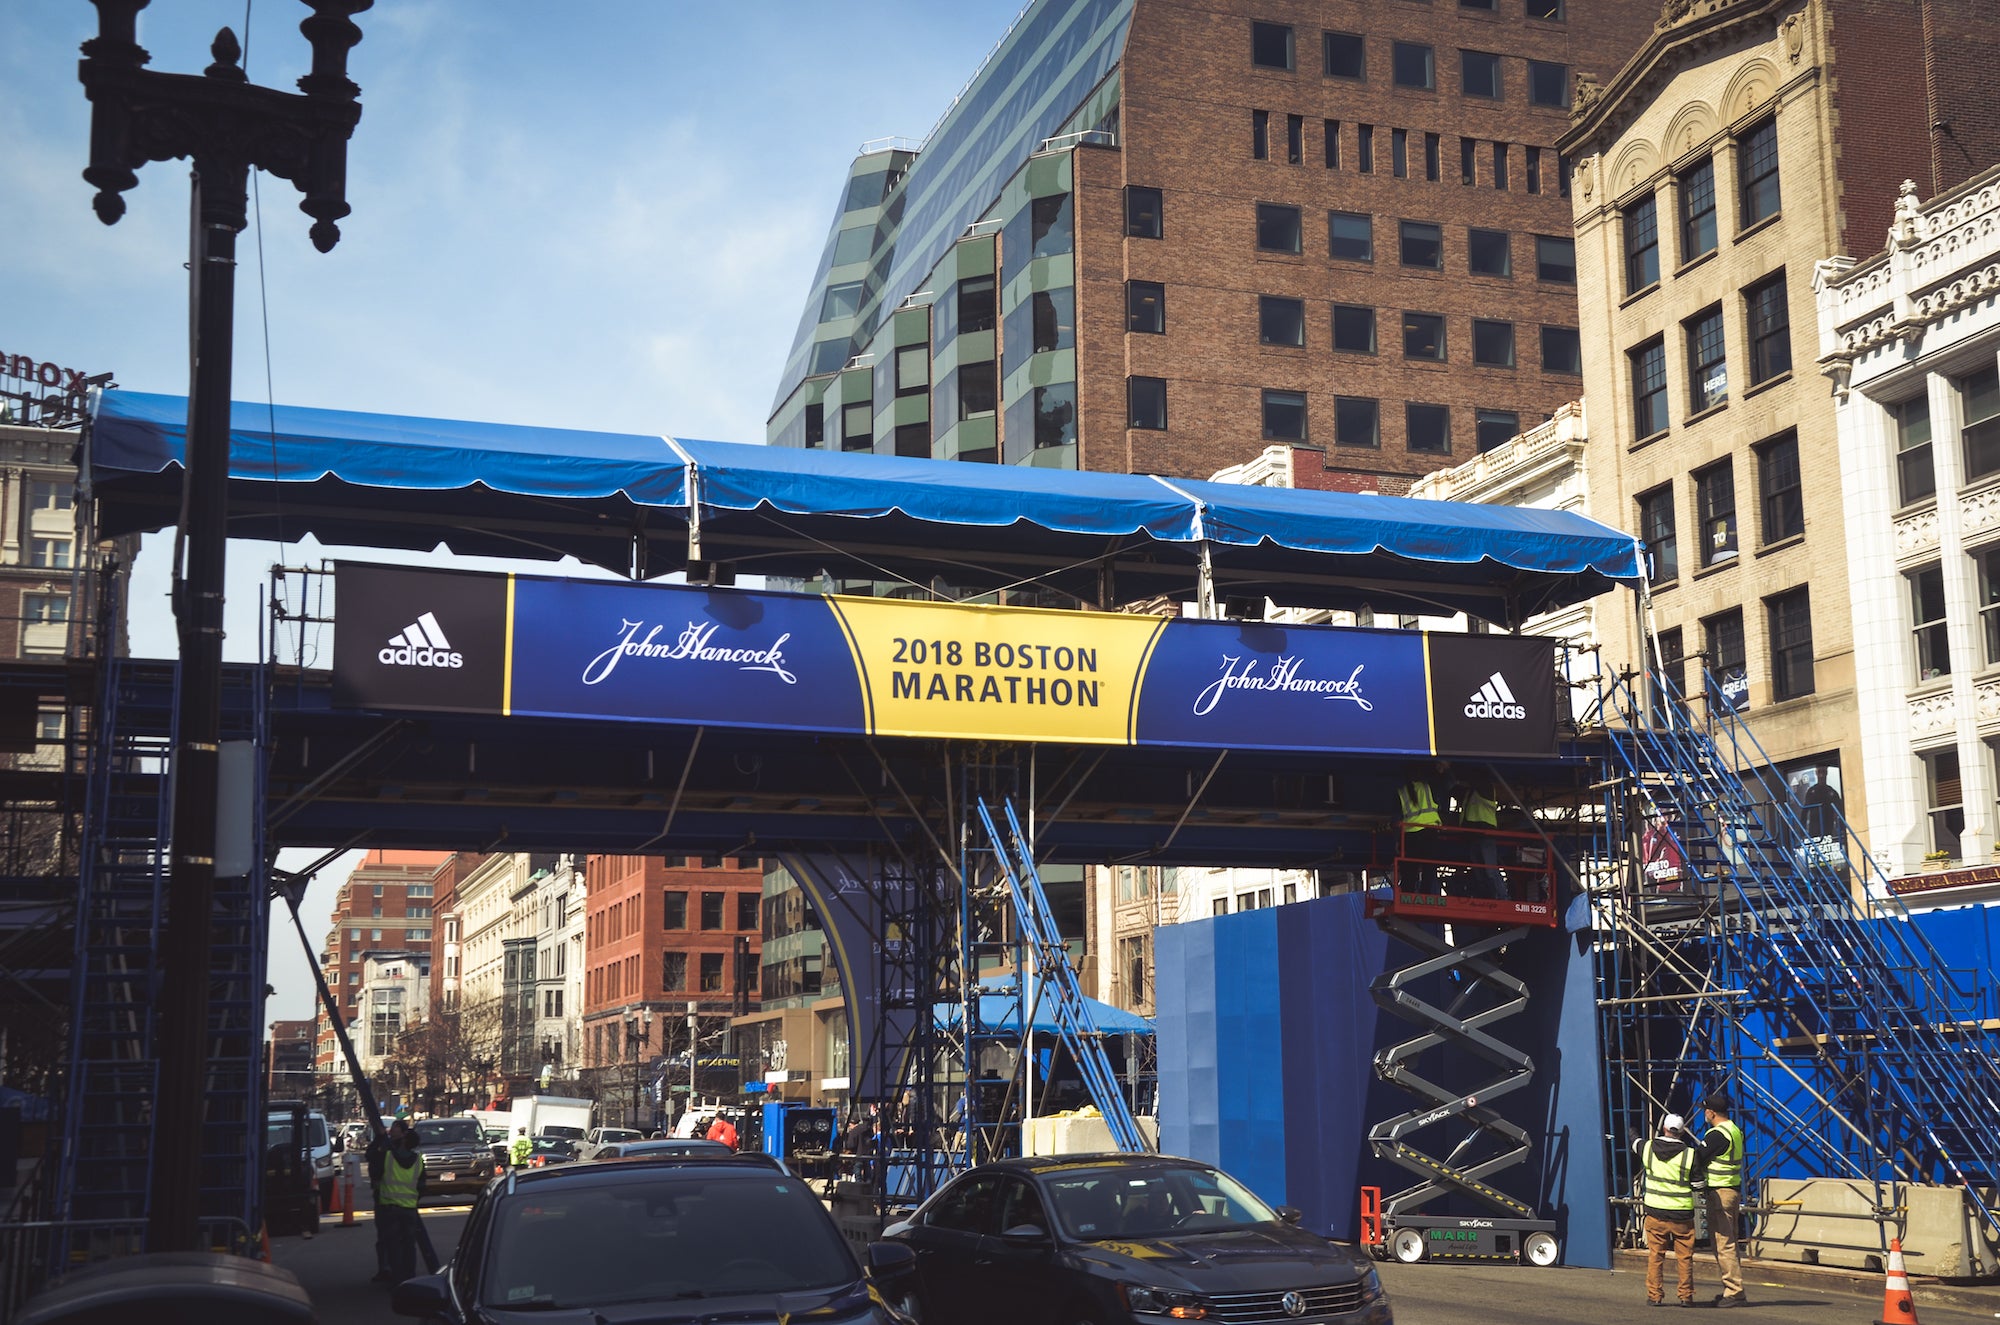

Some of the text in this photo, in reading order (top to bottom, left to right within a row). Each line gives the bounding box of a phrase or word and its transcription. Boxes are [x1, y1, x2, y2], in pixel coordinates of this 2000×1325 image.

[0, 350, 86, 394] nox
[1703, 373, 1727, 393] HERE
[1712, 531, 1726, 545] TO
[378, 644, 463, 669] adidas
[582, 618, 797, 685] John Hancock
[892, 638, 1097, 672] 2018 BOSTON
[892, 671, 1099, 707] MARATHON
[1193, 654, 1374, 716] John Hancock
[1464, 699, 1526, 721] adidas
[1654, 867, 1678, 879] CREATE
[1401, 895, 1447, 906] MARR
[1531, 905, 1547, 914] 3226
[1418, 1109, 1450, 1126] SKYJACK
[1459, 1219, 1493, 1228] SKYJACK
[1430, 1230, 1478, 1241] MARR
